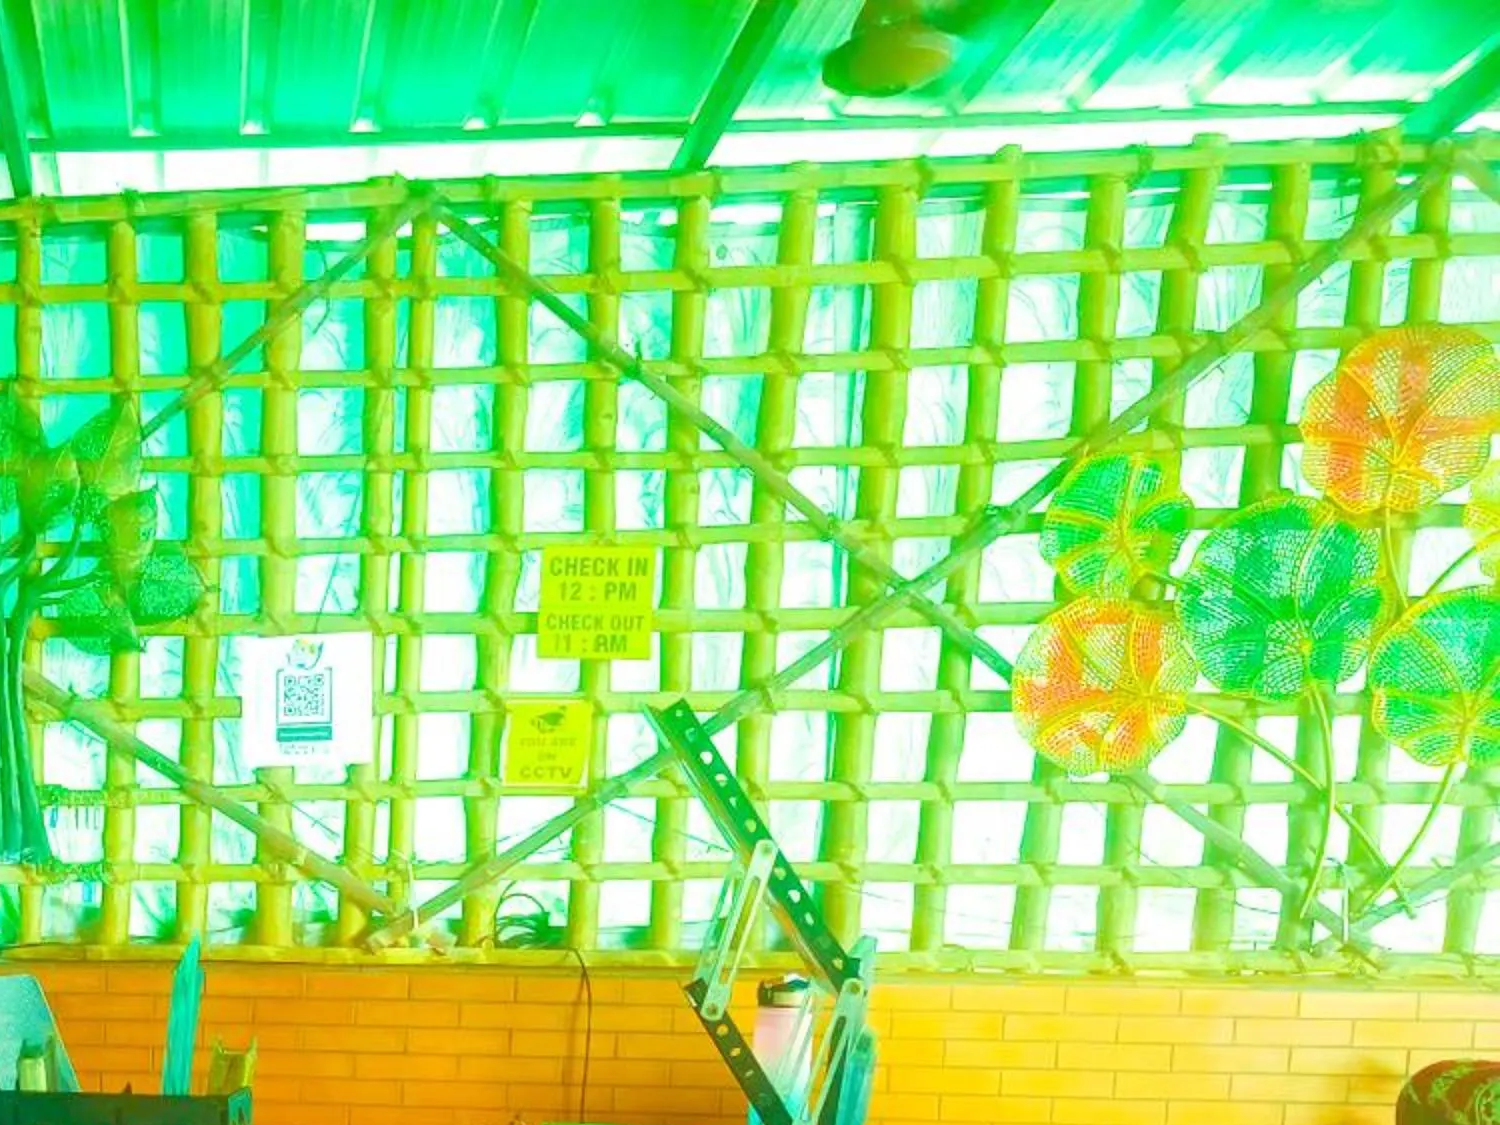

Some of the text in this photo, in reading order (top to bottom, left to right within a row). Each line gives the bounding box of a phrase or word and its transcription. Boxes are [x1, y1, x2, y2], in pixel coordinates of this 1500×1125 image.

[549, 557, 648, 576] CHECK IN
[560, 581, 581, 601] 12
[604, 581, 637, 601] PM
[546, 613, 644, 631] CHECK OUT
[519, 764, 572, 779] CCTV
